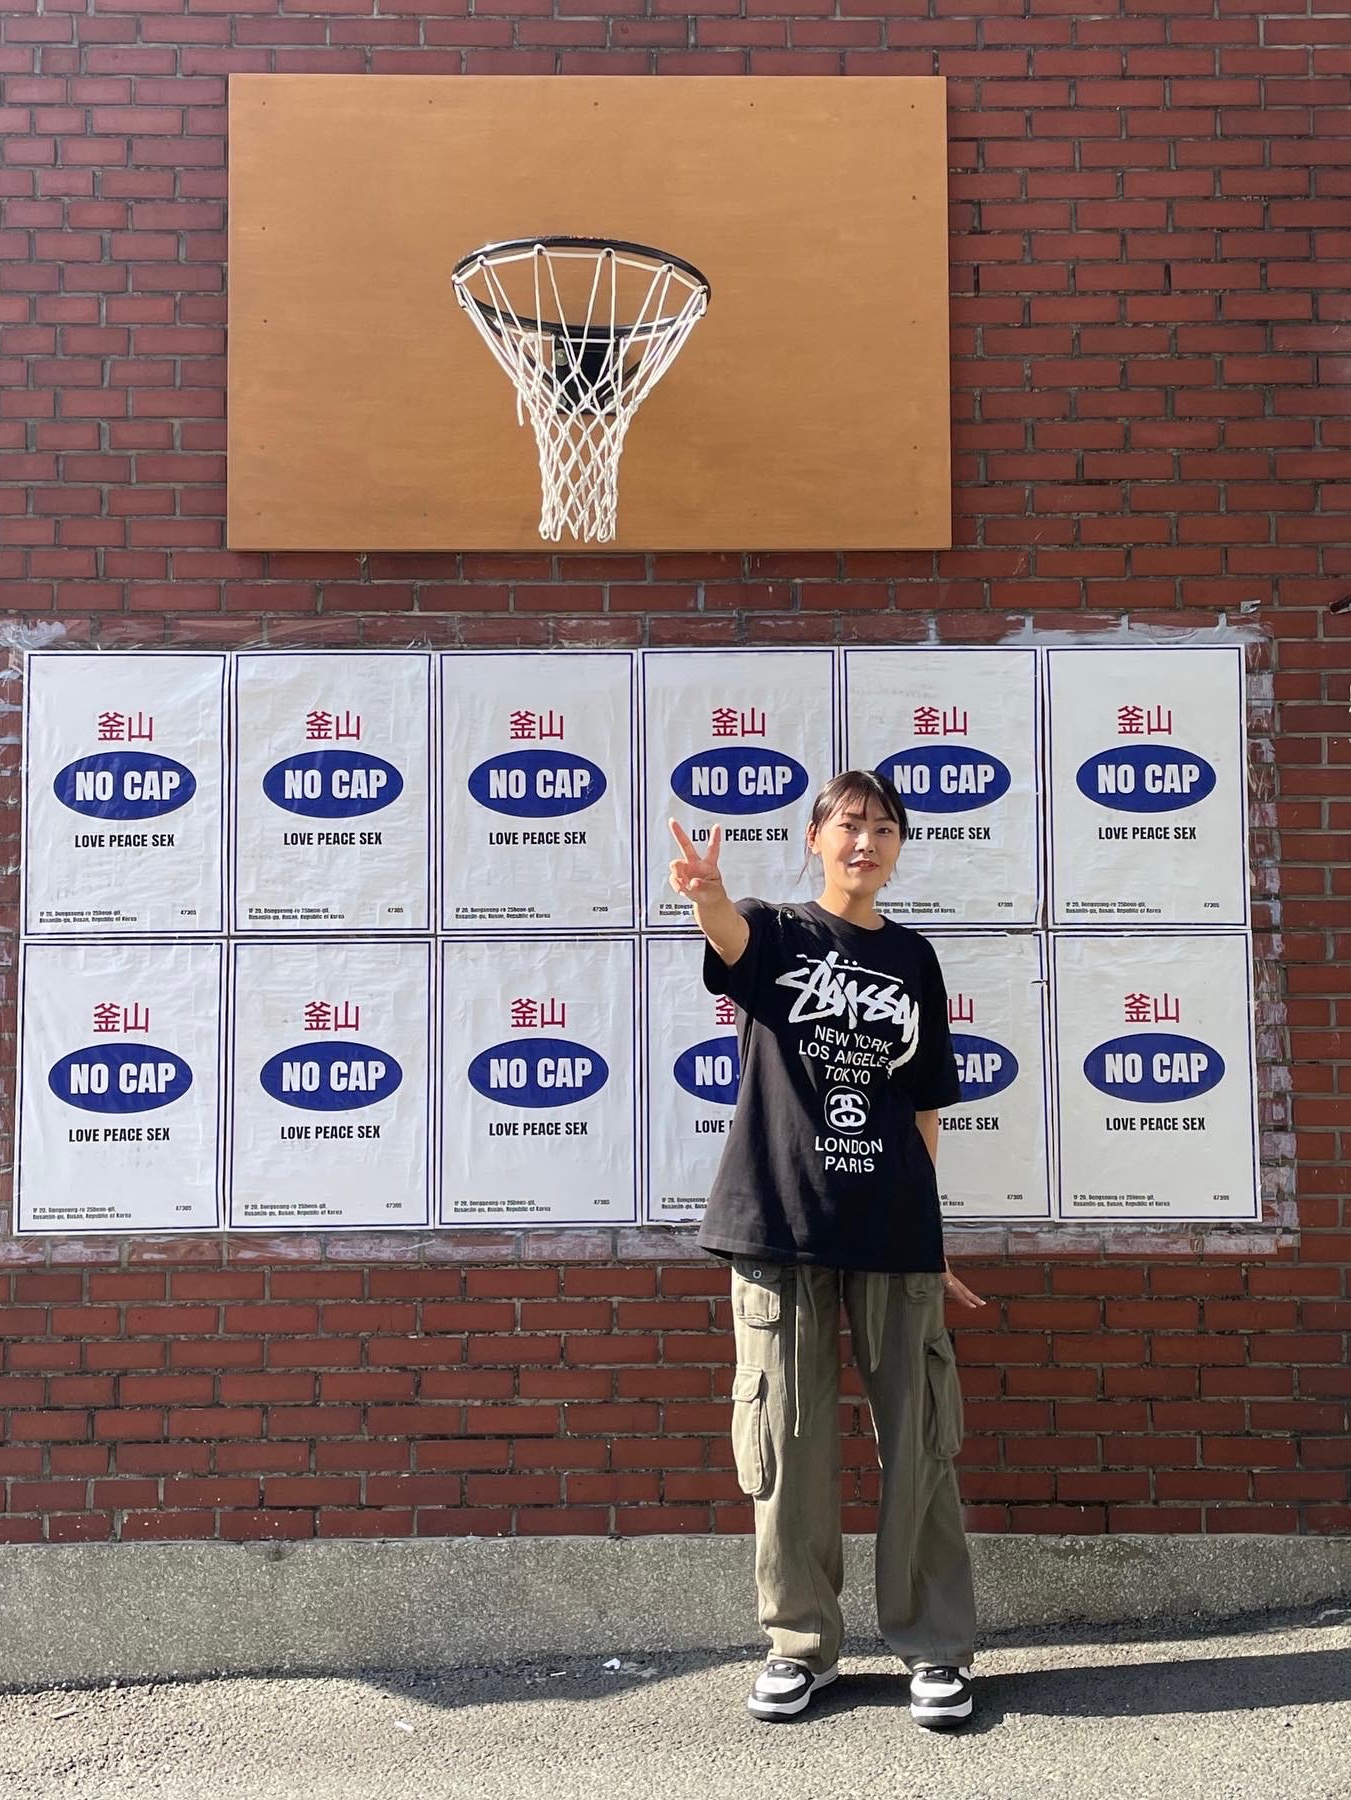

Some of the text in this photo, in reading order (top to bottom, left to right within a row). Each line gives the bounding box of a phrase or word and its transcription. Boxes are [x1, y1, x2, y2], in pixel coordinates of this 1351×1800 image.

[99, 712, 153, 742] 釜山
[306, 711, 360, 740] 釜山
[510, 710, 564, 740] 釜山
[712, 707, 766, 737] 釜山
[913, 706, 968, 736] 釜山
[1118, 705, 1172, 735] 釜山
[75, 770, 181, 801] NO CAP
[284, 768, 388, 800] NO CAP
[489, 768, 591, 799] NO CAP
[691, 765, 793, 796] NO CAP
[893, 764, 995, 795] NO CAP
[1097, 763, 1200, 794] NO CAP
[75, 833, 175, 848] LOVE PEACE SEX
[283, 831, 382, 846] LOVE PEACE SEX
[489, 831, 587, 845] LOVE PEACE SEX
[725, 828, 763, 842] PEACE
[766, 828, 789, 841] SEX
[926, 827, 965, 840] PEACE
[968, 827, 991, 840] SEX
[1098, 826, 1197, 840] LOVE PEACE SEX
[94, 1002, 149, 1033] 釜山
[305, 1001, 359, 1032] 釜山
[511, 998, 566, 1028] 釜山
[1124, 993, 1180, 1023] 釜山
[815, 1025, 893, 1054] NEW YORK
[798, 1040, 894, 1070] LOS ANGELES
[1104, 1052, 1209, 1084] NO CAP
[69, 1062, 177, 1095] NO CAP
[281, 1060, 387, 1092] NO CAP
[489, 1057, 593, 1089] NO CAP
[694, 1055, 733, 1086] NO
[824, 1064, 871, 1085] TOKYO
[68, 1127, 170, 1142] LOVE PEACE SEX
[280, 1125, 381, 1140] LOVE PEACE SEX
[489, 1121, 588, 1136] LOVE PEACE SEX
[695, 1119, 725, 1134] LOVE
[976, 1117, 1000, 1131] SEX
[1105, 1117, 1206, 1131] LOVE PEACE SEX
[815, 1135, 883, 1156] LONDON
[824, 1155, 875, 1174] PARIS
